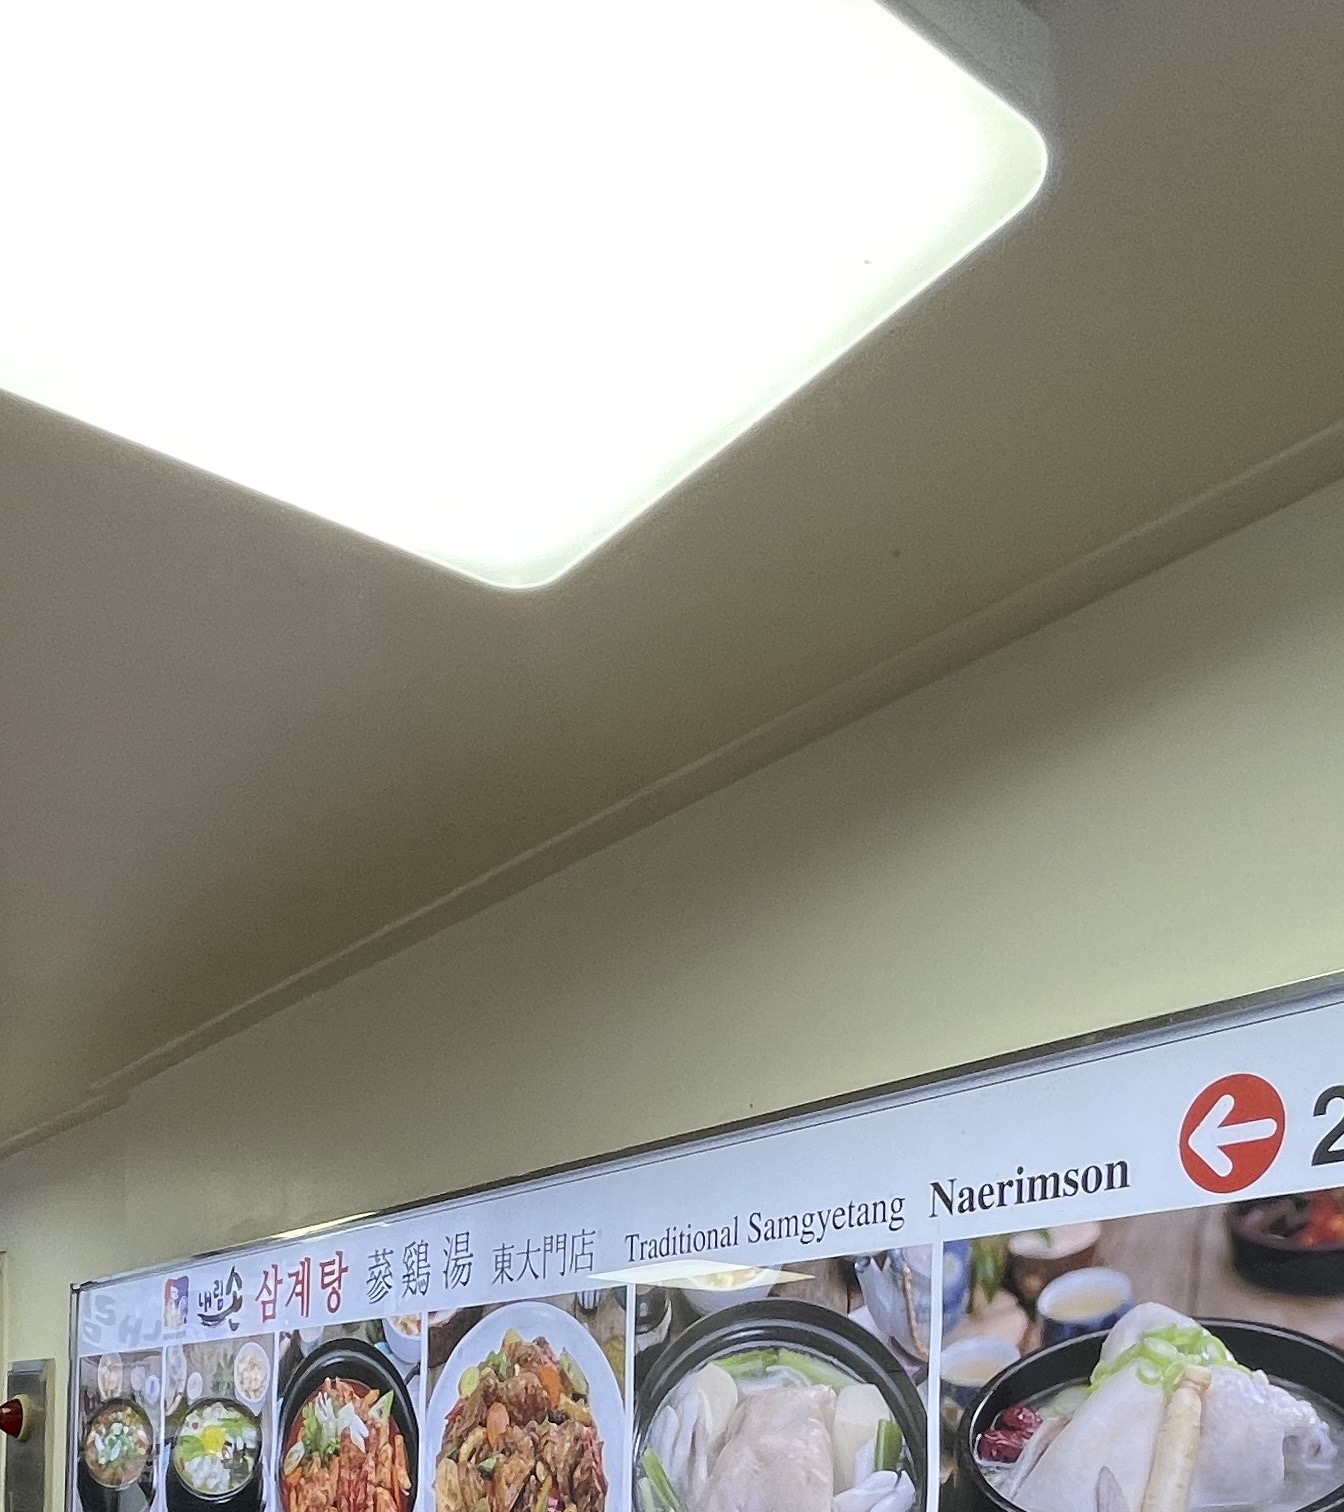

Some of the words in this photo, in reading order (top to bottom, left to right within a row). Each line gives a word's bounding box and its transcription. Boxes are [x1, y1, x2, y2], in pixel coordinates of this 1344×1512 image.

[625, 1216, 739, 1263] Traditional
[747, 1195, 905, 1245] Samgyetang
[929, 1157, 1131, 1219] Naerimson
[256, 1250, 348, 1324] 삼계탕
[492, 1228, 597, 1285] 東大門店
